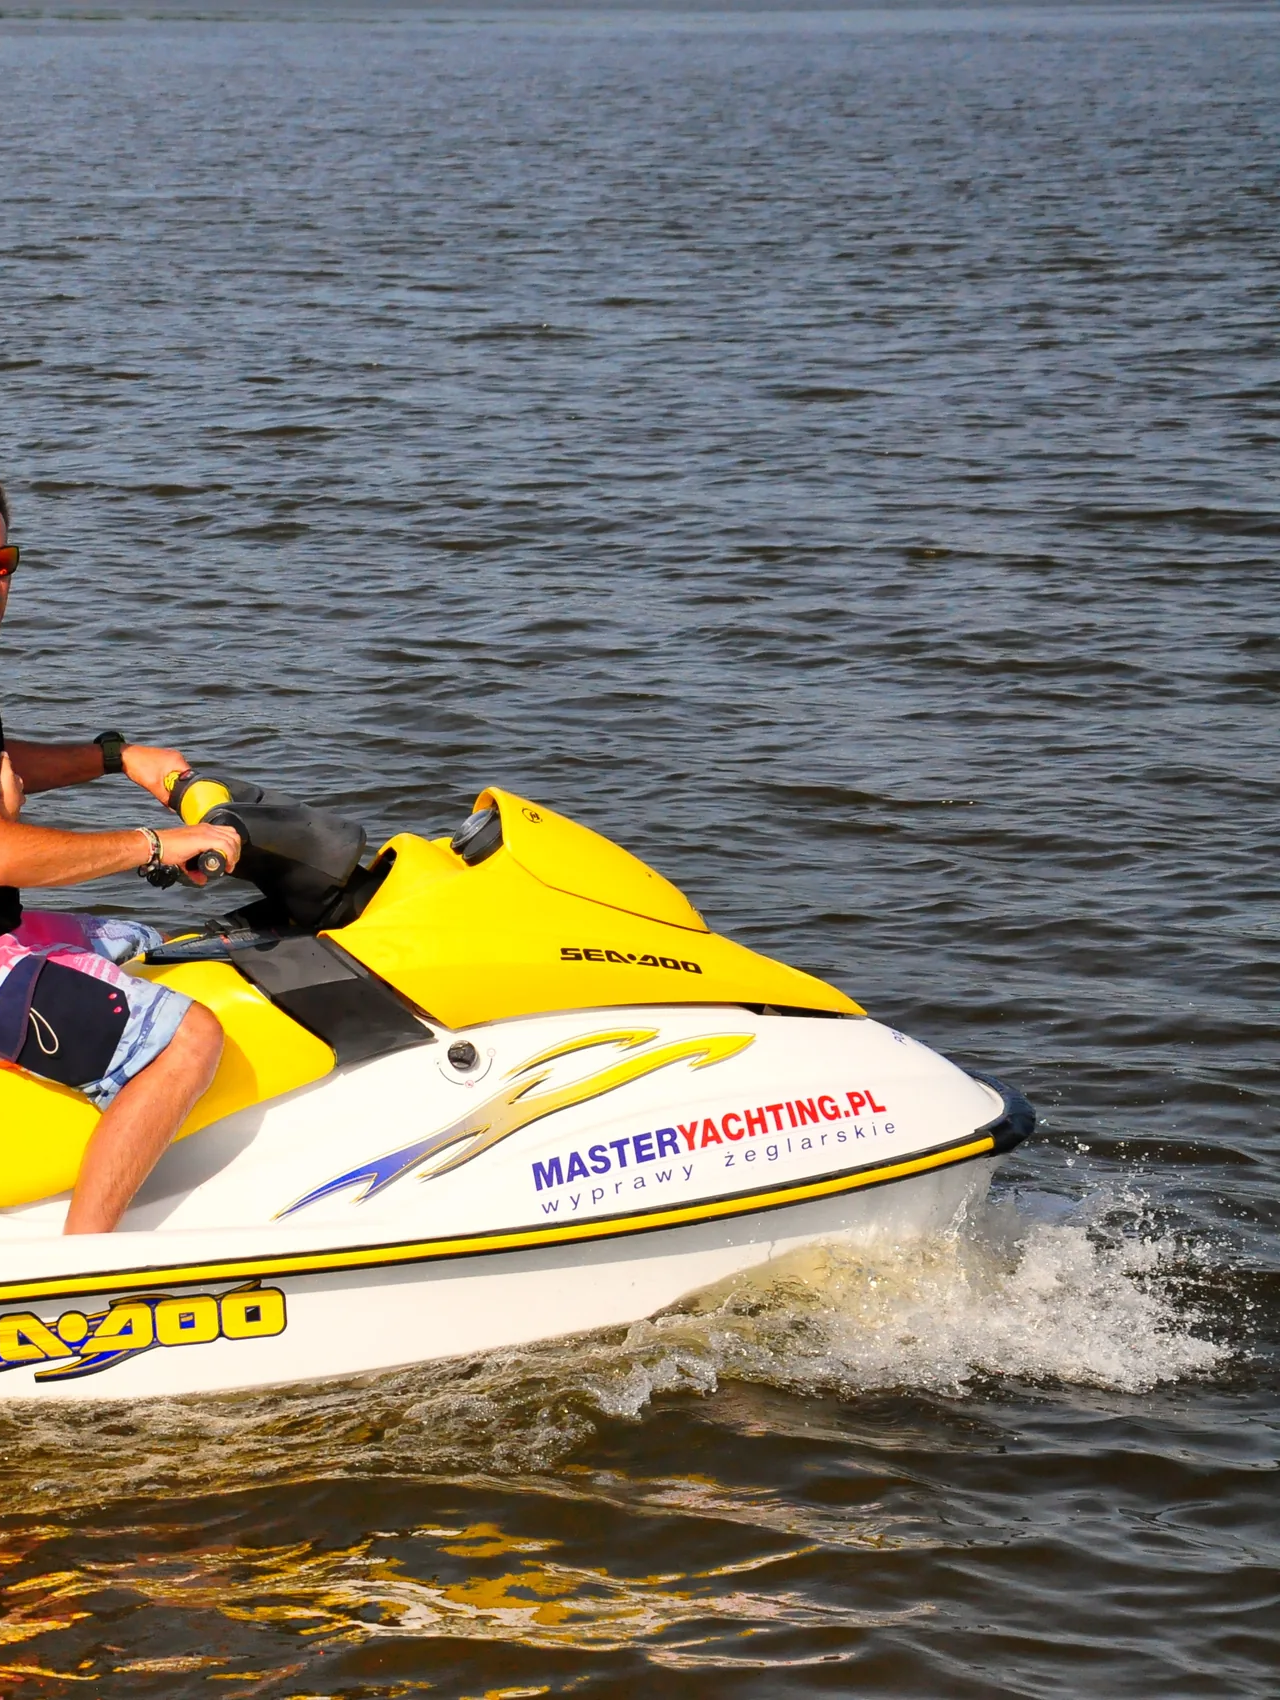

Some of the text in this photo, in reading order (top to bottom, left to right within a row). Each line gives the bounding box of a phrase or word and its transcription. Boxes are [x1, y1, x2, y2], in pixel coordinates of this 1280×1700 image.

[531, 1089, 888, 1192] MASTERYACHTING.PL
[541, 1121, 896, 1215] wyprawy żeglarskie
